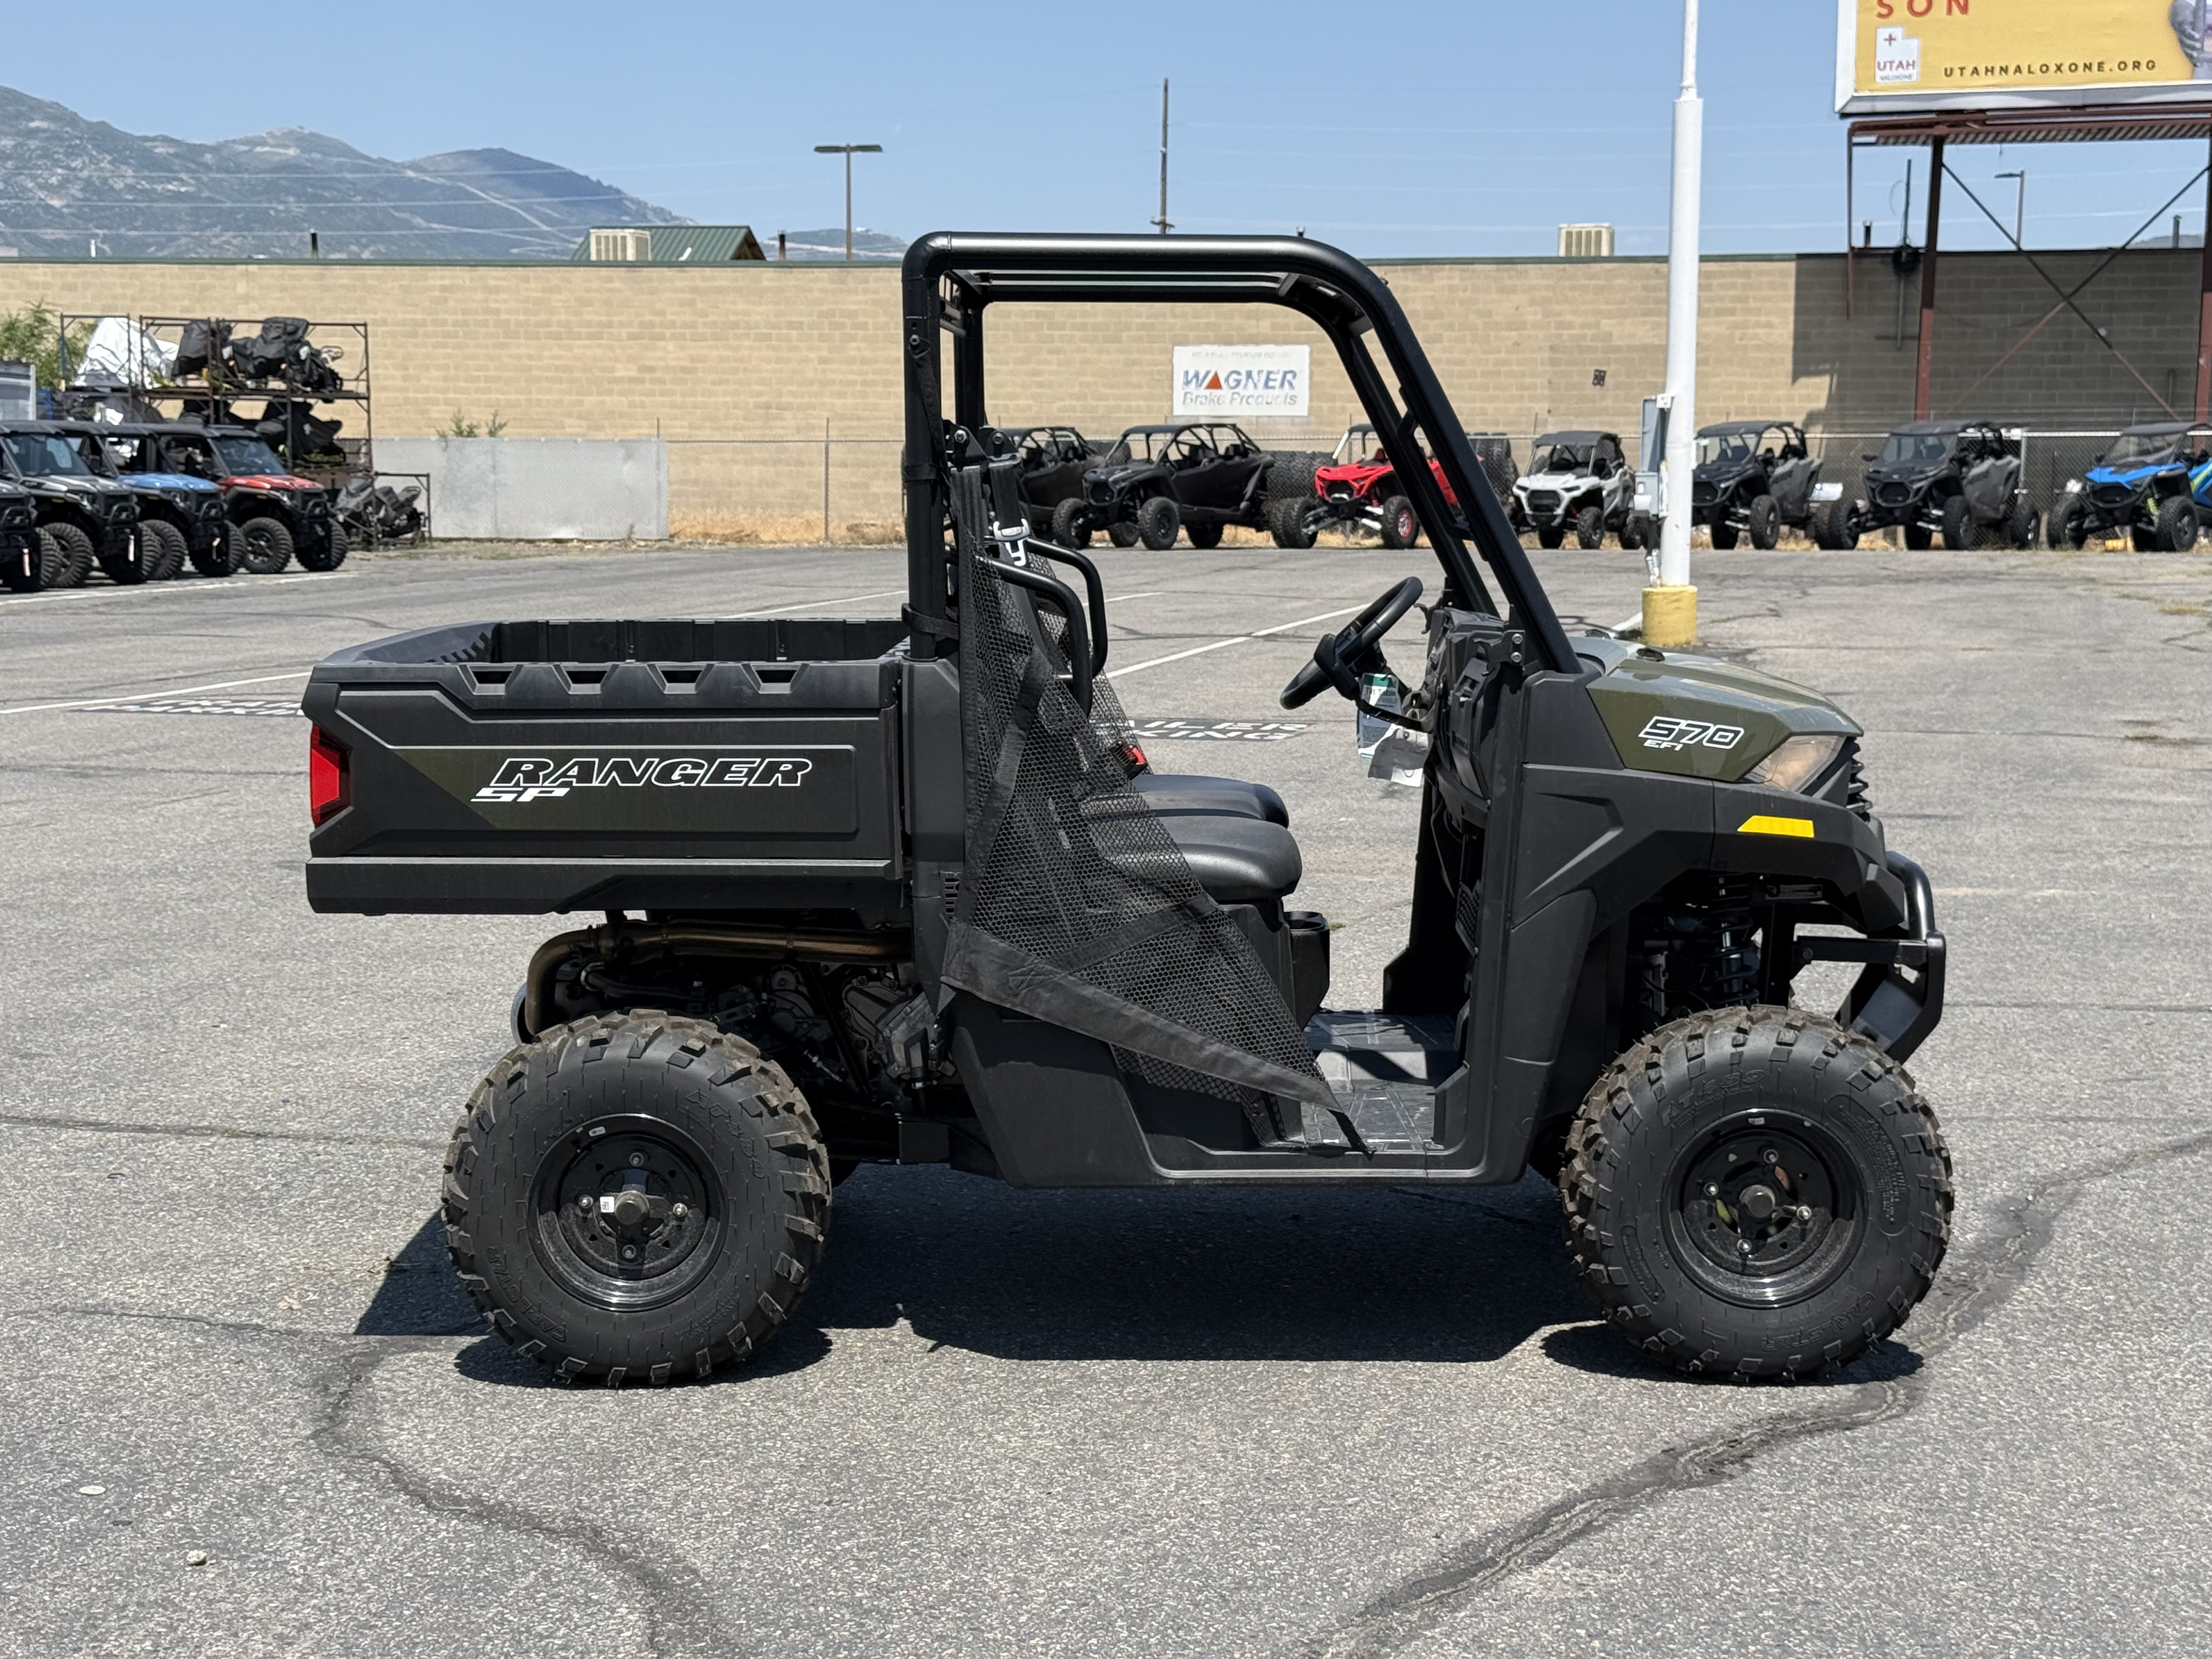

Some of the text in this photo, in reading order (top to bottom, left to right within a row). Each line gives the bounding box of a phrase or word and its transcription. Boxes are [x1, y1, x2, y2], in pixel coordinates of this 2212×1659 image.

[1875, 0, 1970, 19] SON
[1876, 59, 1916, 72] UTAH
[1944, 59, 2157, 78] UTAHNALOXONE.ORG
[1182, 391, 1226, 405] Brake
[1638, 715, 1745, 749] 570
[1643, 739, 1684, 751] EFI
[489, 758, 813, 787] RANGER
[470, 787, 571, 803] SP
[486, 1245, 567, 1342] CARLSTAR
[1761, 1290, 1876, 1351] CARLSTAR
